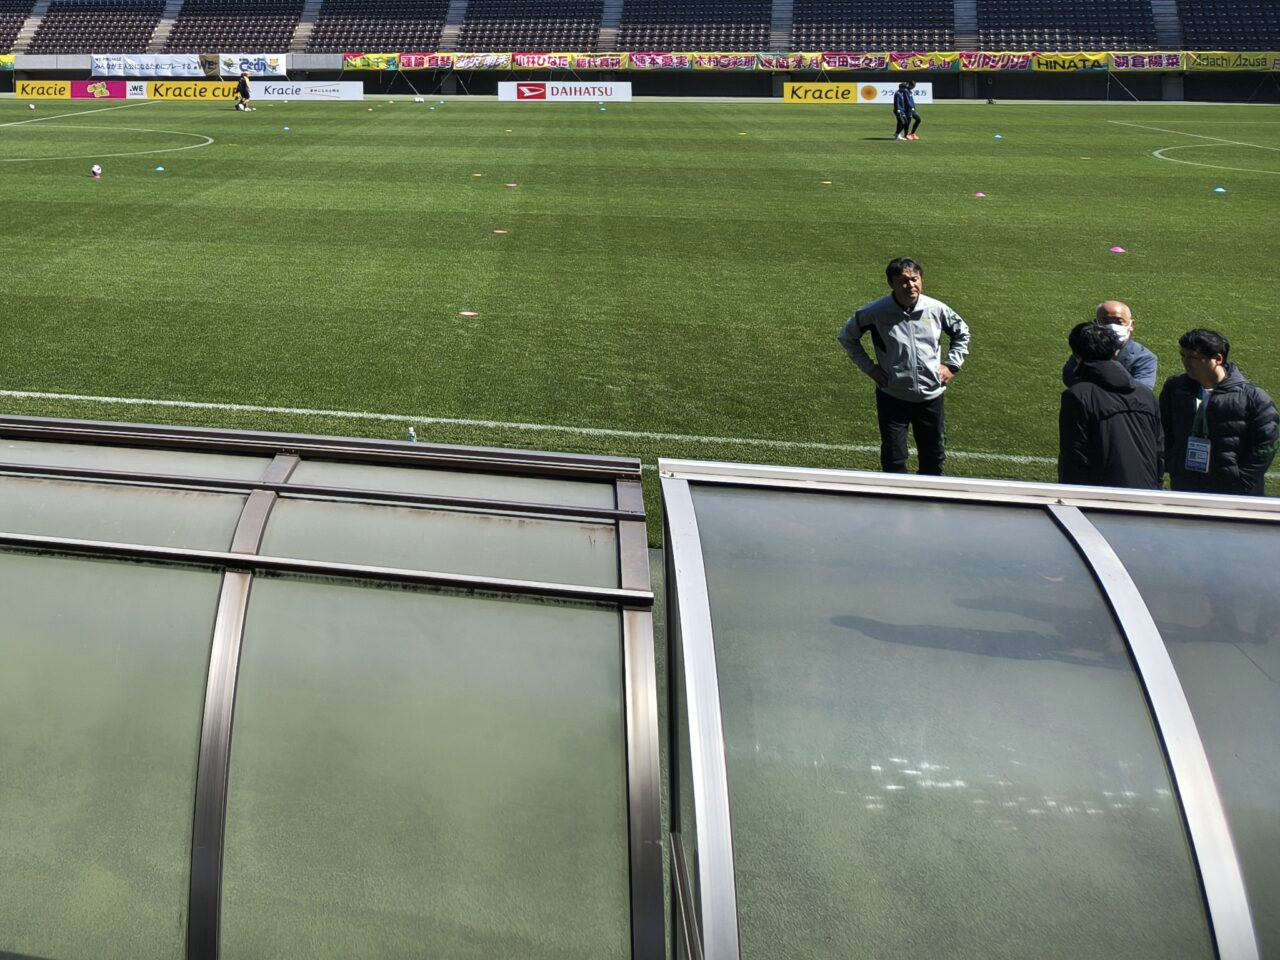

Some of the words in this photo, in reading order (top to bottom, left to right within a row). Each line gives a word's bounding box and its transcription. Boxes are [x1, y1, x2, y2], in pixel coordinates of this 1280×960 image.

[514, 54, 568, 67] 小林ひなた
[1037, 58, 1104, 70] HINATA
[21, 83, 66, 96] Kracie
[153, 83, 207, 97] Kracie
[263, 85, 302, 96] Kracie
[551, 86, 613, 97] DAIHATSU
[790, 85, 851, 100] Kracie
